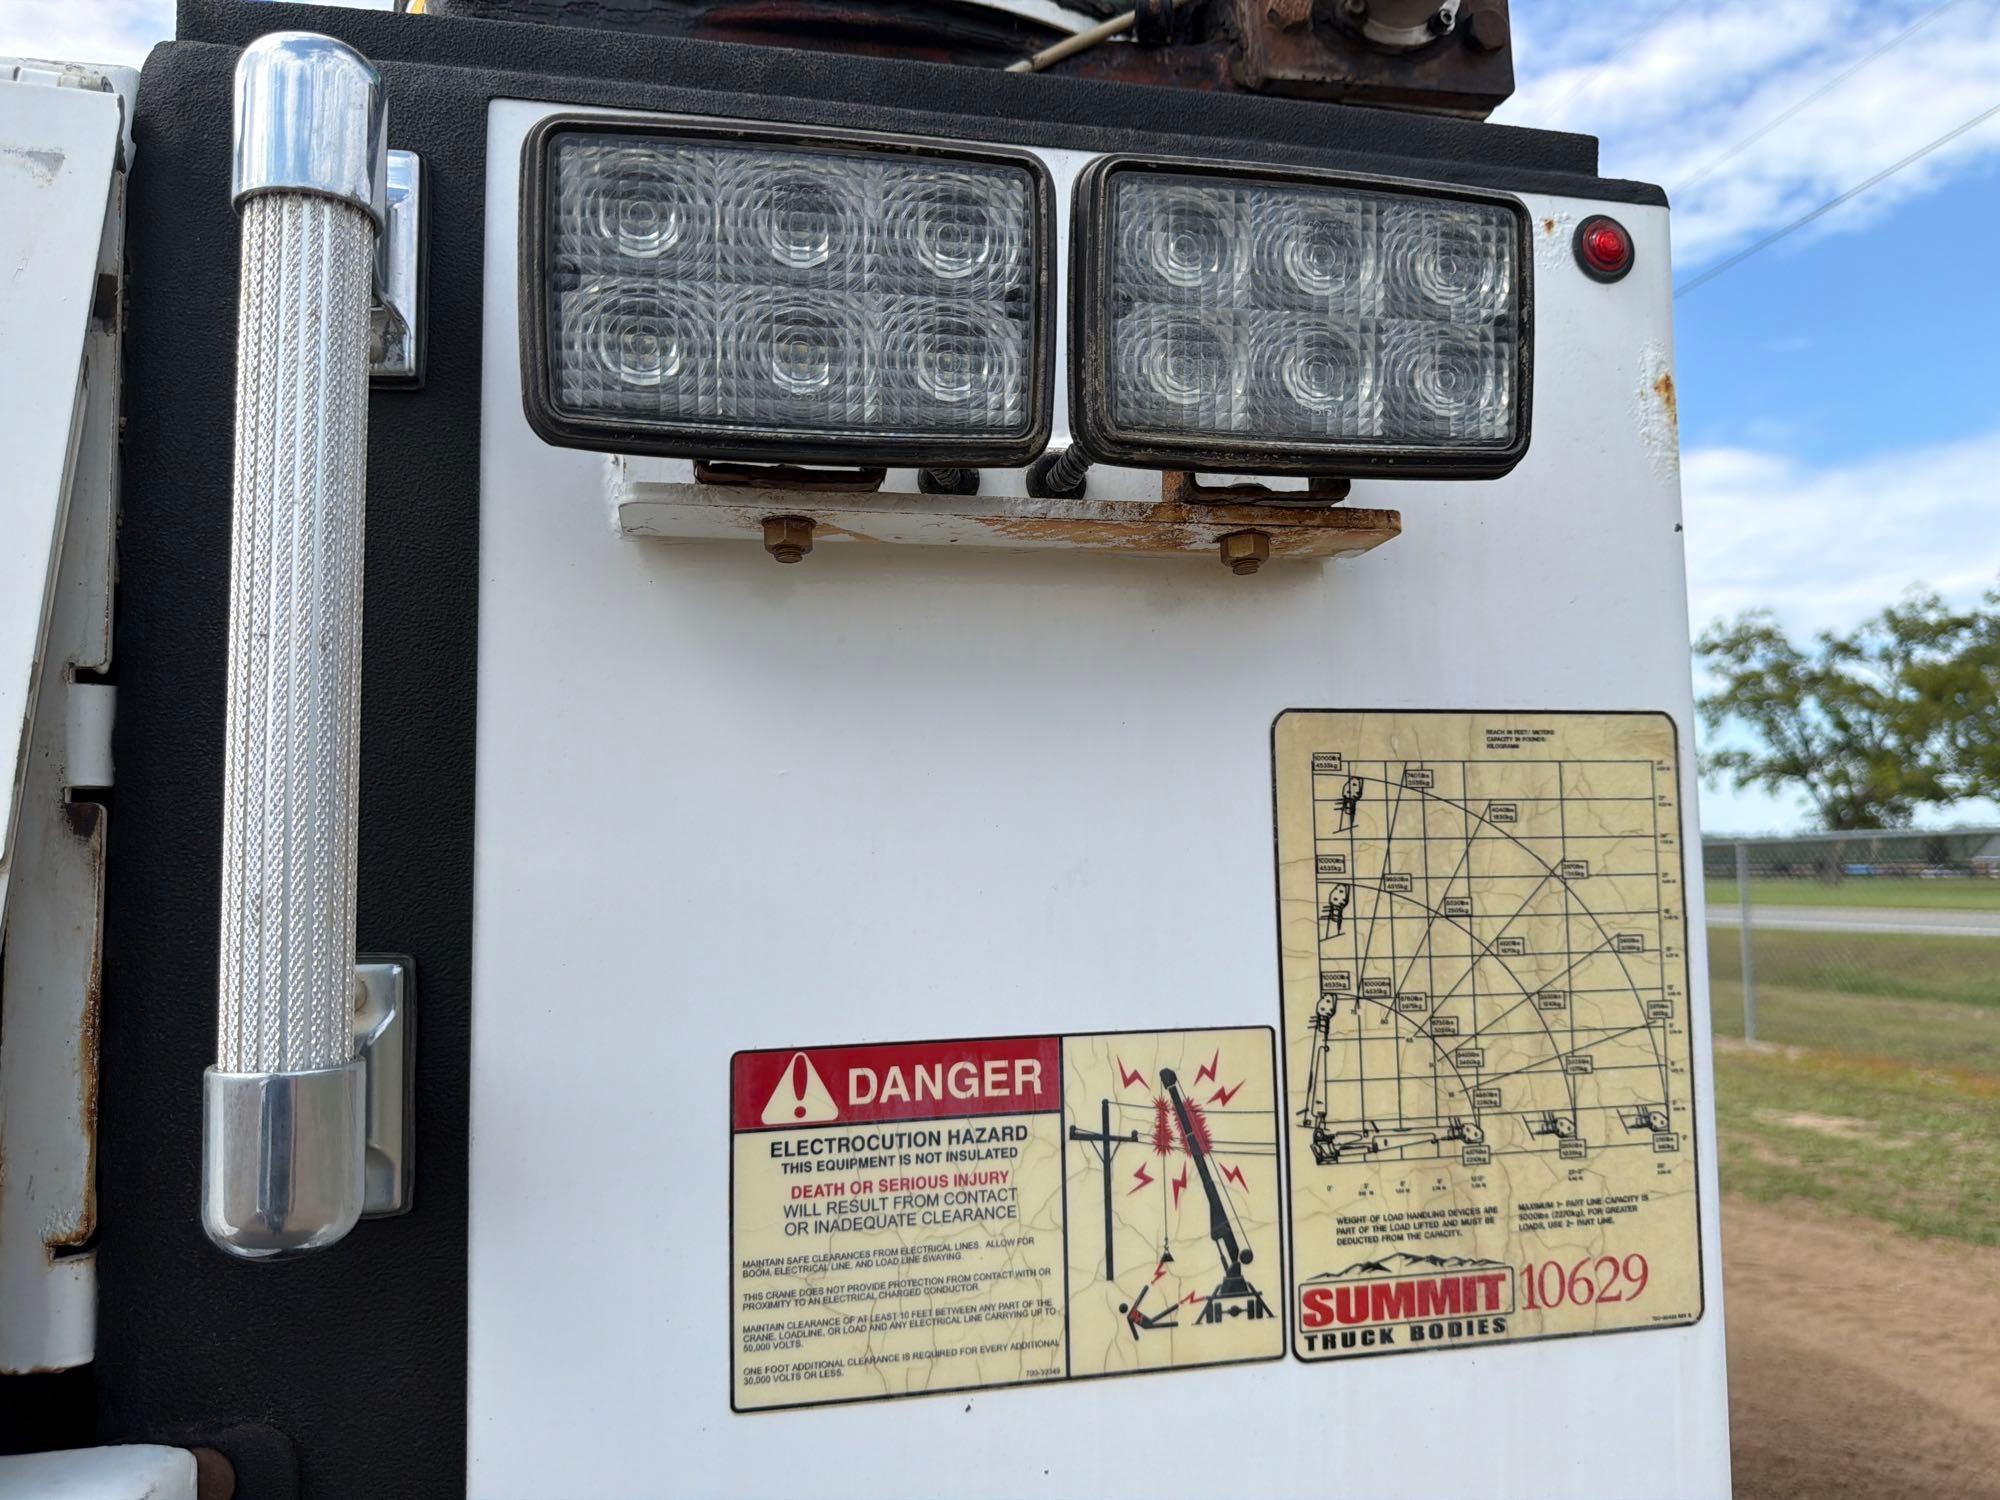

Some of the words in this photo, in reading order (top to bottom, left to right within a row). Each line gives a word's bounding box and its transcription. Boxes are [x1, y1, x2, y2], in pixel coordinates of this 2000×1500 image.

[848, 1058, 1043, 1105] DANGER
[770, 1131, 940, 1157] ELECTROCUTION
[948, 1125, 1028, 1145] HAZARD
[781, 1161, 812, 1174] THIS
[816, 1155, 896, 1171] EQUIPMENT
[899, 1154, 911, 1165] IS
[915, 1152, 942, 1164] NOT
[945, 1147, 1018, 1162] INSULATED
[790, 1182, 844, 1199] DEATH
[850, 1180, 873, 1194] OR
[878, 1175, 948, 1192] SERIOUS
[953, 1171, 1009, 1187] INJURY
[783, 1202, 821, 1217] WILL
[826, 1197, 888, 1214] RESULT
[893, 1193, 939, 1209] FROM
[943, 1188, 1017, 1205] CONTACT
[1336, 1216, 1366, 1225] WEIGHT
[1382, 1213, 1403, 1221] LOAD
[1406, 1210, 1445, 1220] HANDLING
[1447, 1208, 1480, 1217] DEVICES
[1518, 1202, 1553, 1210] MAXIMUM
[1604, 1196, 1638, 1204] CAPACITY
[784, 1221, 809, 1235] OR
[814, 1213, 916, 1233] INADEQUATE
[921, 1205, 1016, 1225] CLEARANCE
[1336, 1227, 1355, 1235] PART
[1389, 1223, 1410, 1231] LOAD
[1413, 1221, 1438, 1229] LIFTED
[1460, 1218, 1482, 1226] MUST
[742, 1258, 784, 1267] MAINTAIN
[786, 1256, 809, 1264] SAFE
[811, 1251, 870, 1262] CLEARANCES
[873, 1249, 898, 1257] FROM
[900, 1244, 952, 1255] ELECTRICAL
[985, 1239, 1015, 1248] ALLOW
[1336, 1236, 1378, 1245] DEDUCTED
[1381, 1234, 1403, 1242] FROM
[774, 1263, 828, 1274] ELECTRICAL
[854, 1260, 873, 1268] AND
[875, 1258, 899, 1266] LOAD
[900, 1256, 919, 1264] LINE
[743, 1292, 763, 1301] THIS
[765, 1290, 796, 1299] CRANE
[798, 1287, 823, 1296] DOES
[847, 1282, 885, 1292] PROVIDE
[888, 1277, 943, 1288] PROTECTION
[946, 1275, 971, 1283] FROM
[973, 1271, 1012, 1281] CONTACT
[1014, 1269, 1036, 1277] WITH
[1519, 1253, 1650, 1311] 10629
[742, 1299, 791, 1310] PROXIMITY
[794, 1298, 807, 1306] TO
[822, 1292, 876, 1303] ELECTRICAL
[878, 1288, 921, 1298] CHARGED
[1301, 1273, 1507, 1328] SUMMIT
[742, 1323, 784, 1332] MAINTAIN
[786, 1318, 840, 1329] CLEARANCE
[870, 1313, 896, 1321] LEAST
[935, 1306, 976, 1315] BETWEEN
[998, 1302, 1019, 1310] PART
[827, 1327, 840, 1335] OR
[843, 1325, 866, 1333] LOAD
[869, 1323, 887, 1331] AND
[889, 1321, 907, 1329] ANY
[909, 1316, 961, 1327] ELECTRICAL
[964, 1314, 982, 1322] LINE
[984, 1310, 1028, 1320] CARRYING
[1304, 1326, 1394, 1351] TRUCK
[1409, 1316, 1508, 1342] BODIES
[743, 1367, 761, 1375] ONE
[764, 1364, 790, 1373] FOOT
[792, 1359, 844, 1370] ADDITIONAL
[847, 1354, 900, 1365] CLEARANCE
[912, 1348, 957, 1359] REQUIRED
[959, 1346, 977, 1354] FOR
[979, 1344, 1008, 1353] EVERY
[1010, 1339, 1059, 1350] ADDITIONAL
[773, 1373, 801, 1382] VOLTS
[803, 1371, 816, 1379] OR
